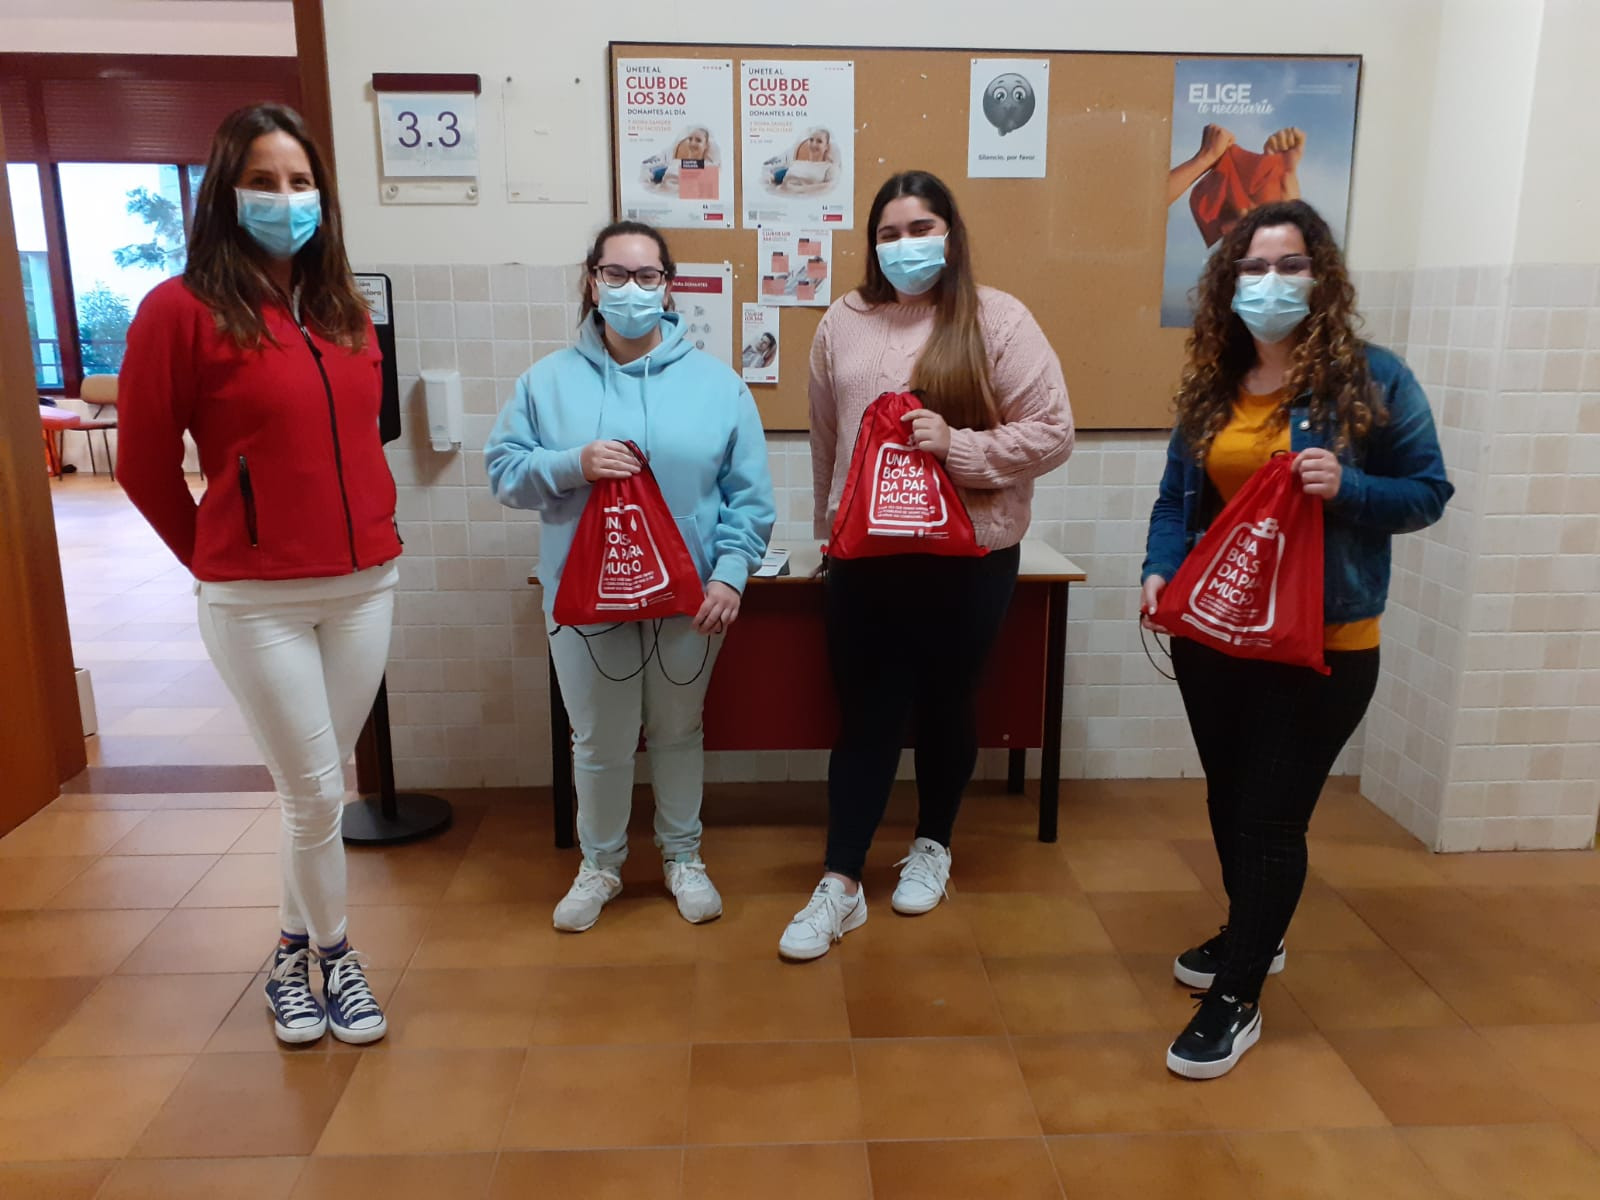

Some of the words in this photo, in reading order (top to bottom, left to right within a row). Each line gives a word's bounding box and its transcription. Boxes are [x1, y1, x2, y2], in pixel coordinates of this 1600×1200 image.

[626, 76, 666, 90] CLUB
[669, 76, 688, 90] DE
[748, 77, 788, 91] CLUB
[791, 78, 809, 91] DE
[627, 91, 654, 105] LOS
[749, 93, 776, 106] LOS
[1188, 83, 1252, 103] ELIGE
[627, 108, 664, 116] DONANTES
[1212, 99, 1274, 114] necesario
[397, 111, 461, 148] 3.3
[886, 452, 910, 467] UNA
[882, 465, 924, 480] BOLSA
[880, 481, 898, 493] DA
[902, 479, 928, 491] PAR
[1226, 547, 1260, 574] BOLS
[1217, 563, 1238, 583] DA
